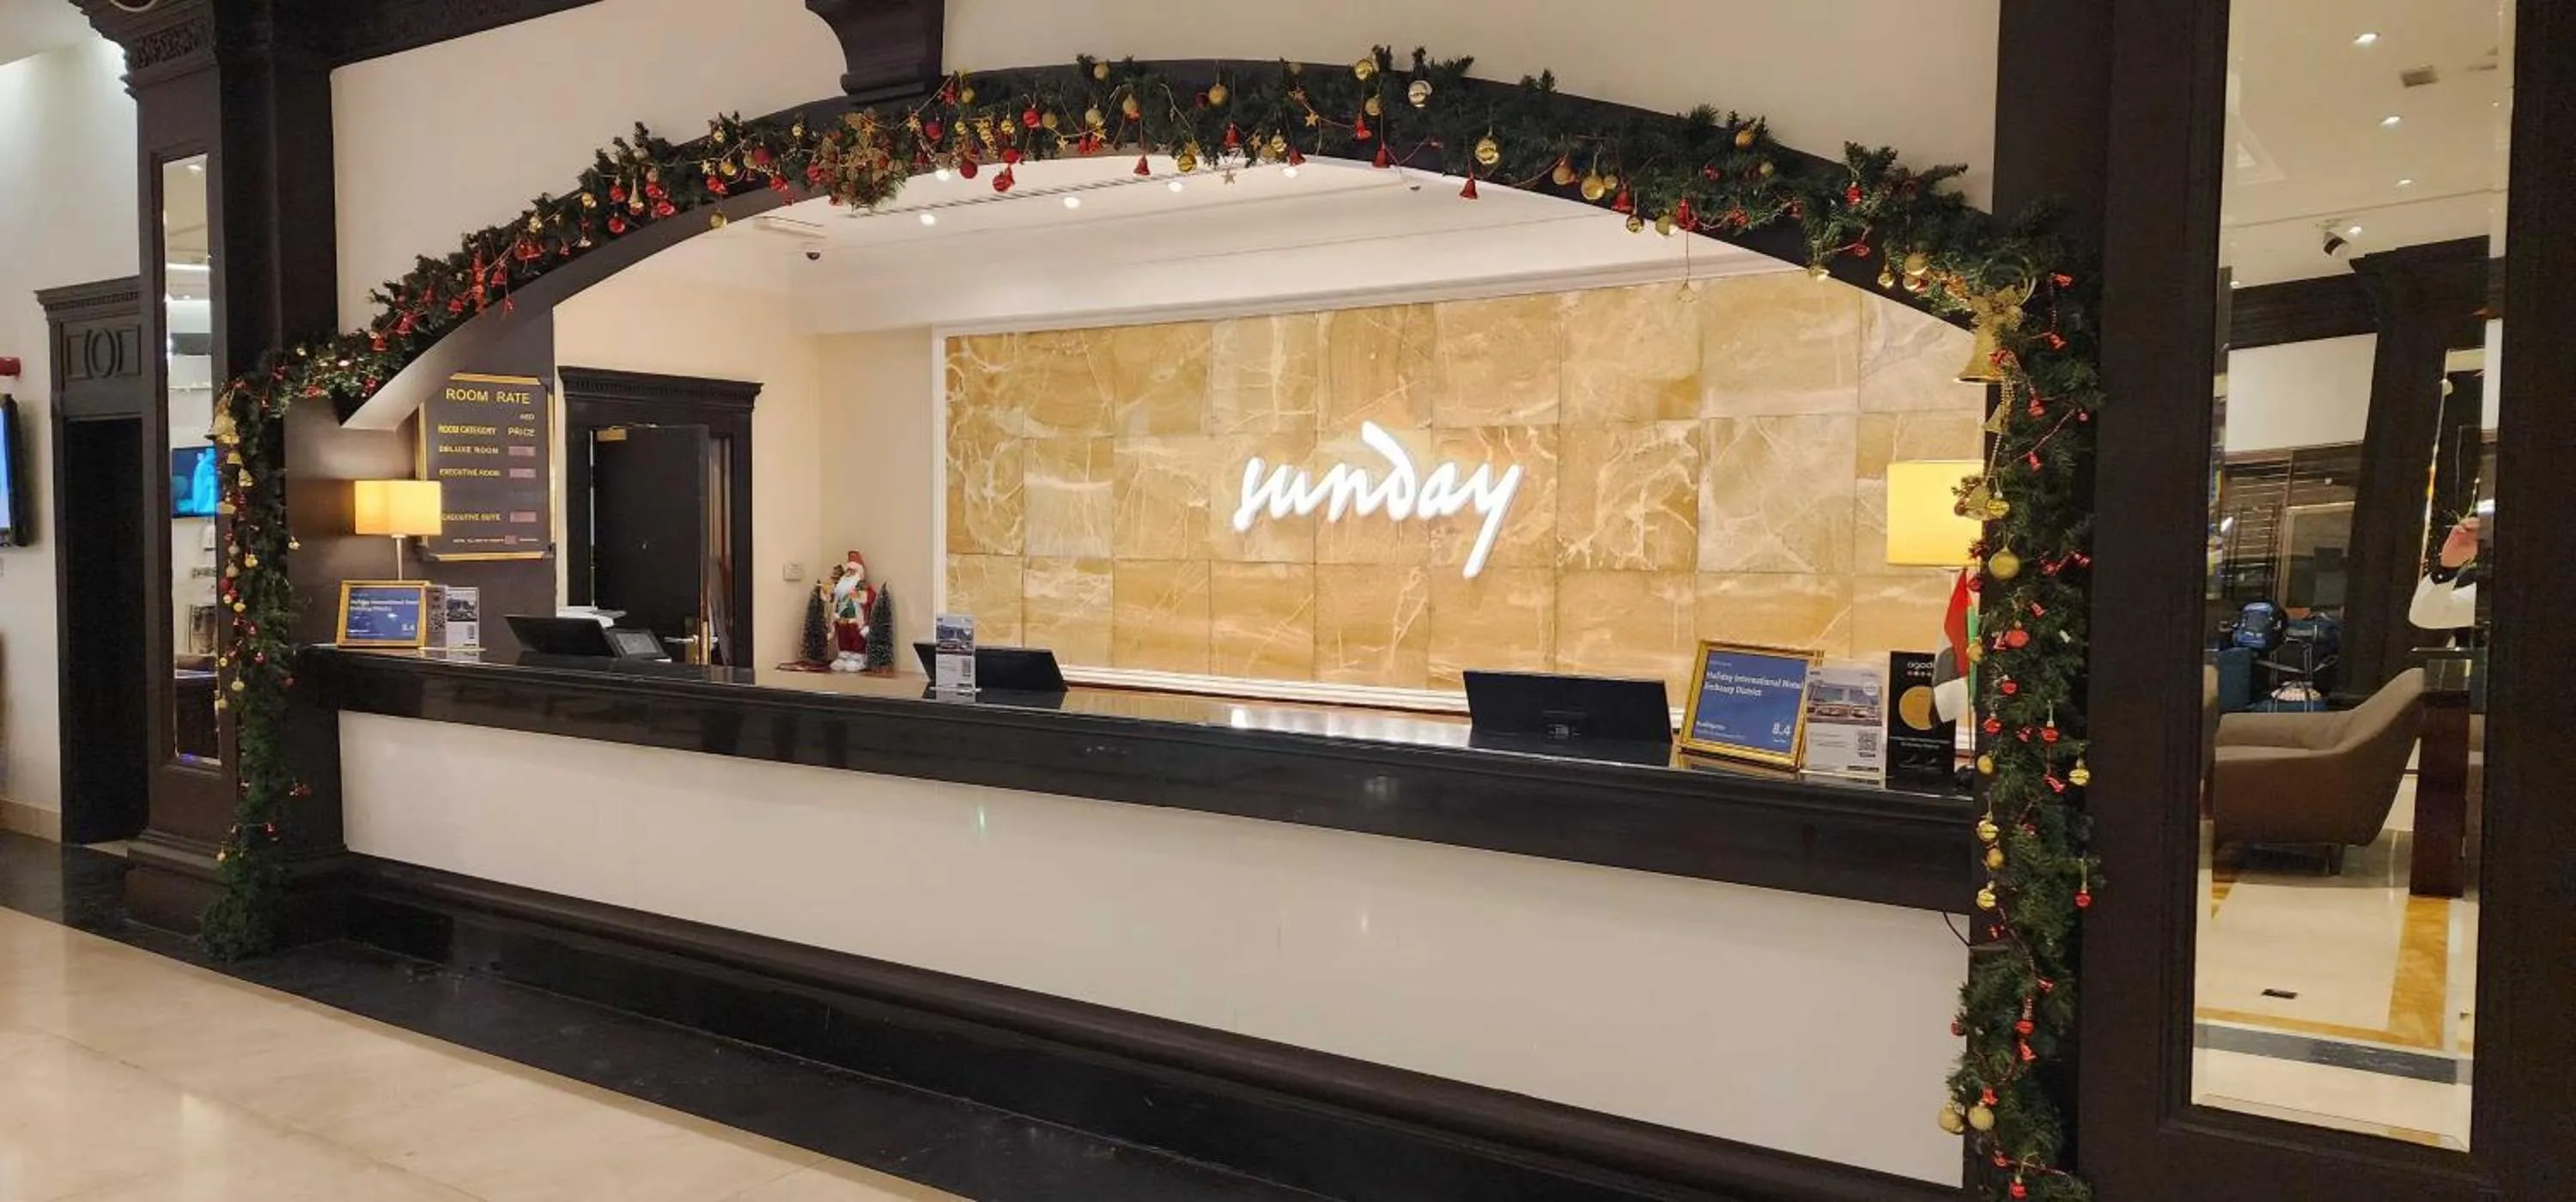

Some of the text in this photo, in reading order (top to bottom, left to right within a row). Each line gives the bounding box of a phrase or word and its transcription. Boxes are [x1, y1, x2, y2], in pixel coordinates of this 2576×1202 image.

[446, 388, 532, 404] ROOM RATE
[438, 424, 459, 434] ROOM
[507, 427, 535, 437] PRICE
[439, 445, 499, 454] DELUXE ROOM
[1233, 420, 1523, 579] sunday
[1907, 660, 1934, 671] agod
[1706, 671, 1734, 683] Holiday
[1735, 674, 1782, 688] International
[1771, 721, 1791, 736] 8.4
